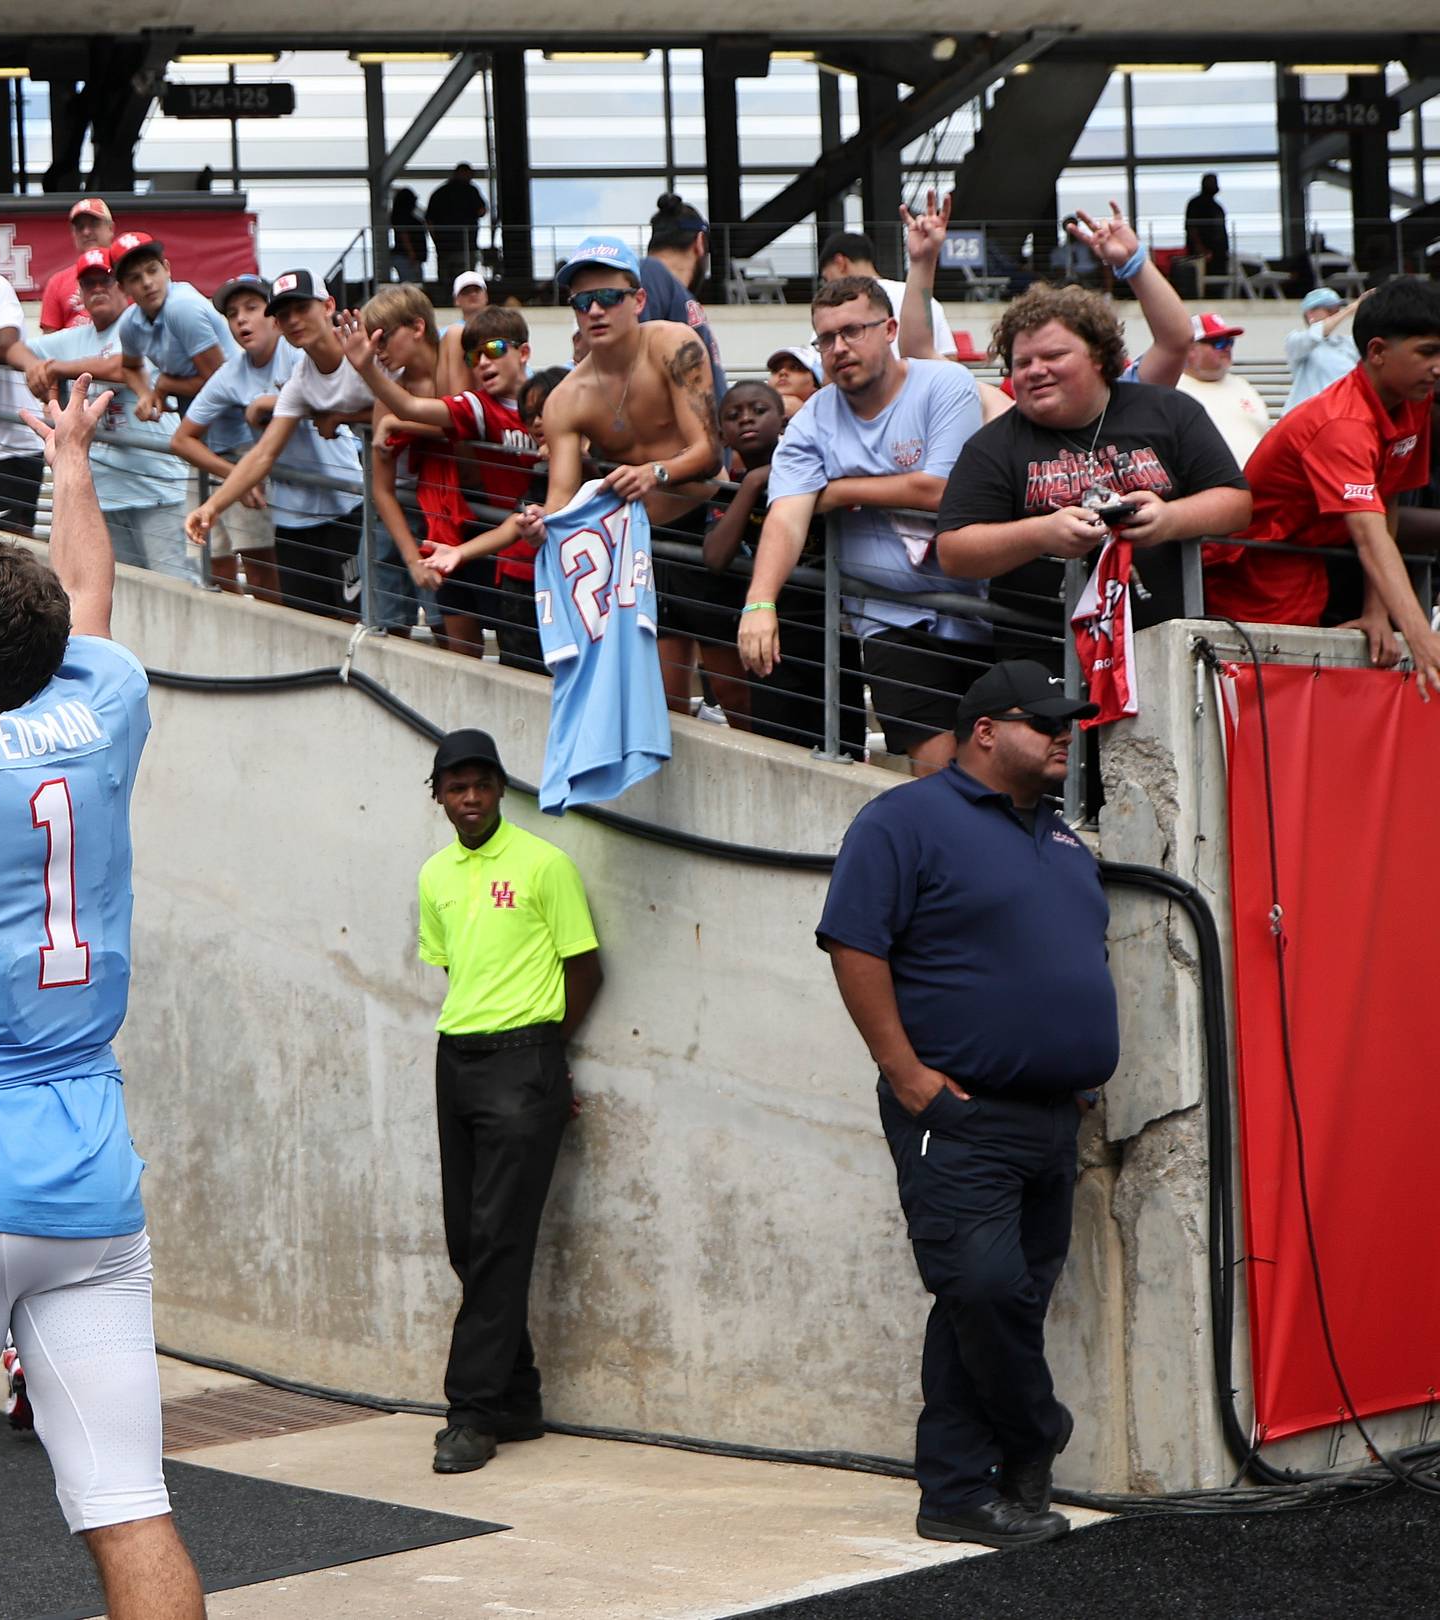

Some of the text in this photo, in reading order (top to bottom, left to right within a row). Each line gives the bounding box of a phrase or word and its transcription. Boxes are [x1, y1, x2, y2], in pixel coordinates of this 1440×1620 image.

[190, 88, 269, 109] 124-125
[1303, 104, 1379, 125] 125-126
[946, 239, 979, 257] 125
[29, 777, 90, 990] 1
[491, 881, 516, 909] UH
